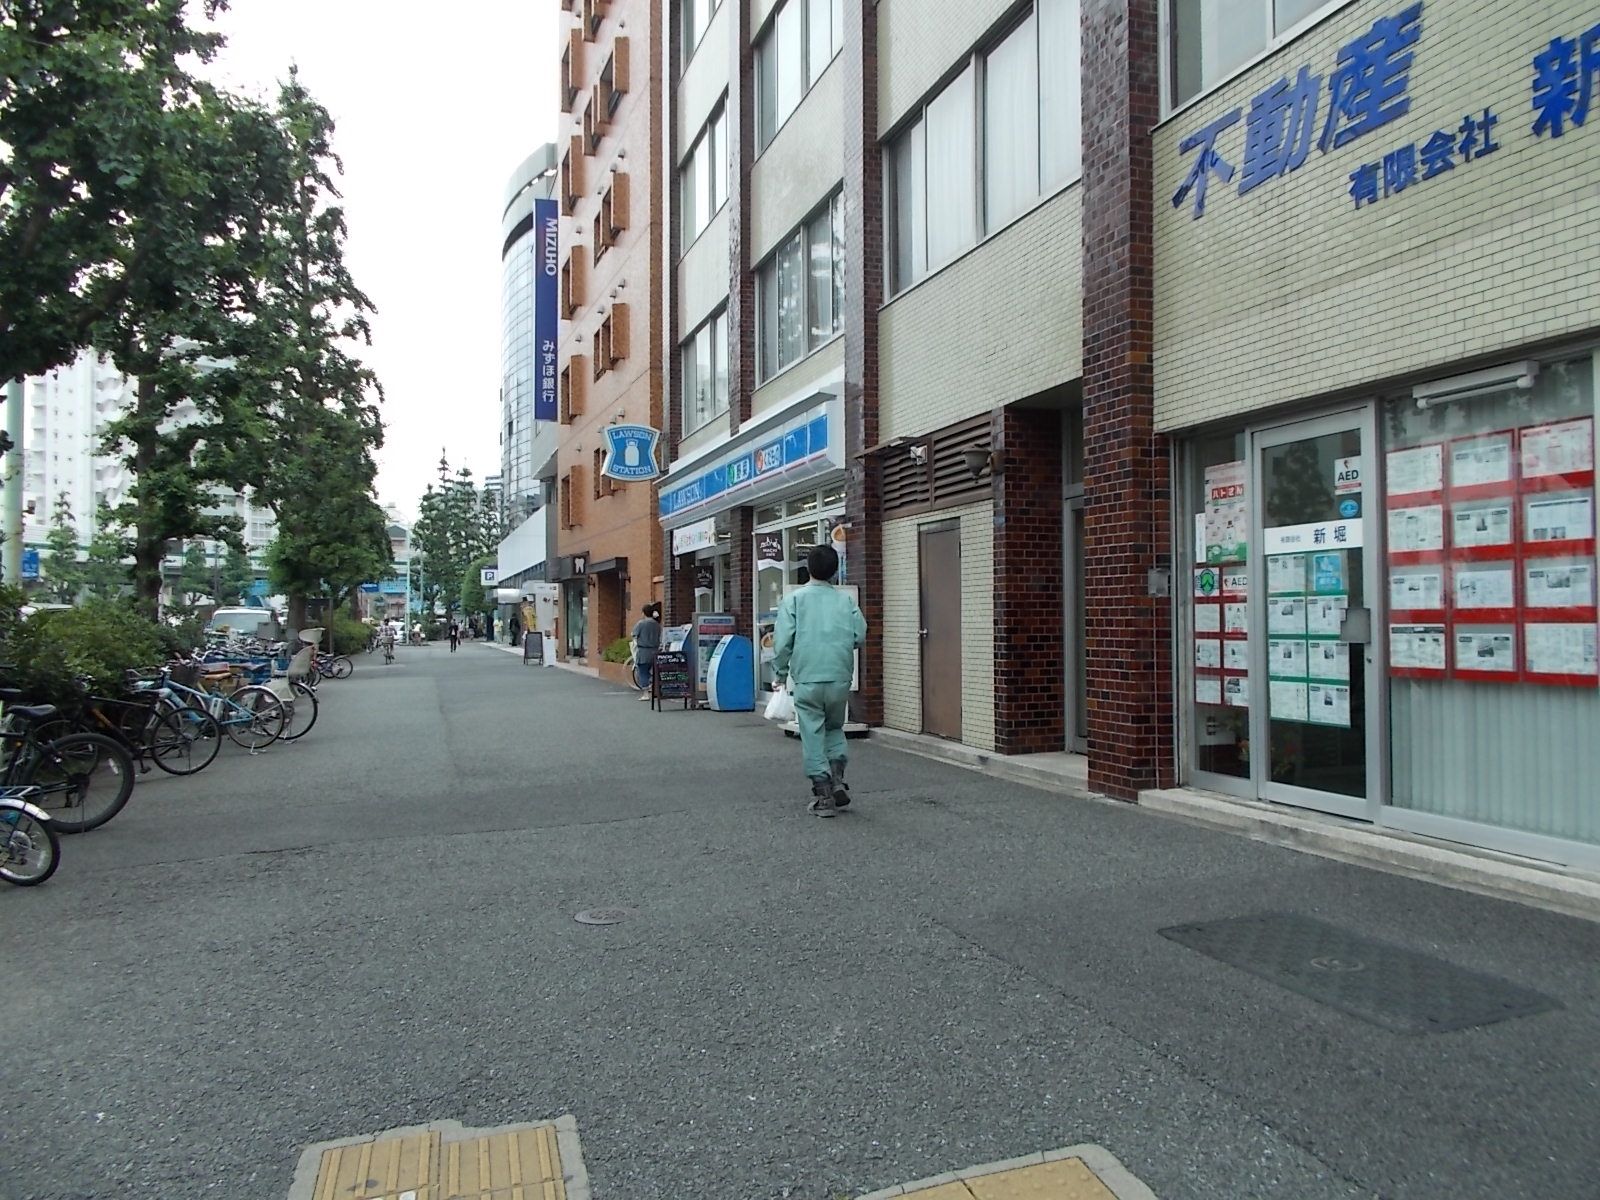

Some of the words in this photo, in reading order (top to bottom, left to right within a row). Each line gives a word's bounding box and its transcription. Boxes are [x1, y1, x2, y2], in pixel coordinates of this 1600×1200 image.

[1531, 24, 1600, 139] 新
[1171, 1, 1424, 220] 不動産
[1348, 106, 1502, 210] 有限会社
[545, 217, 558, 276] MIZUHO
[542, 340, 556, 403] みずほ銀行
[612, 428, 652, 440] LAWSON
[612, 464, 651, 475] STATION
[1338, 469, 1359, 481] AED
[672, 482, 701, 510] LAWSON
[1313, 525, 1347, 544] 新堀
